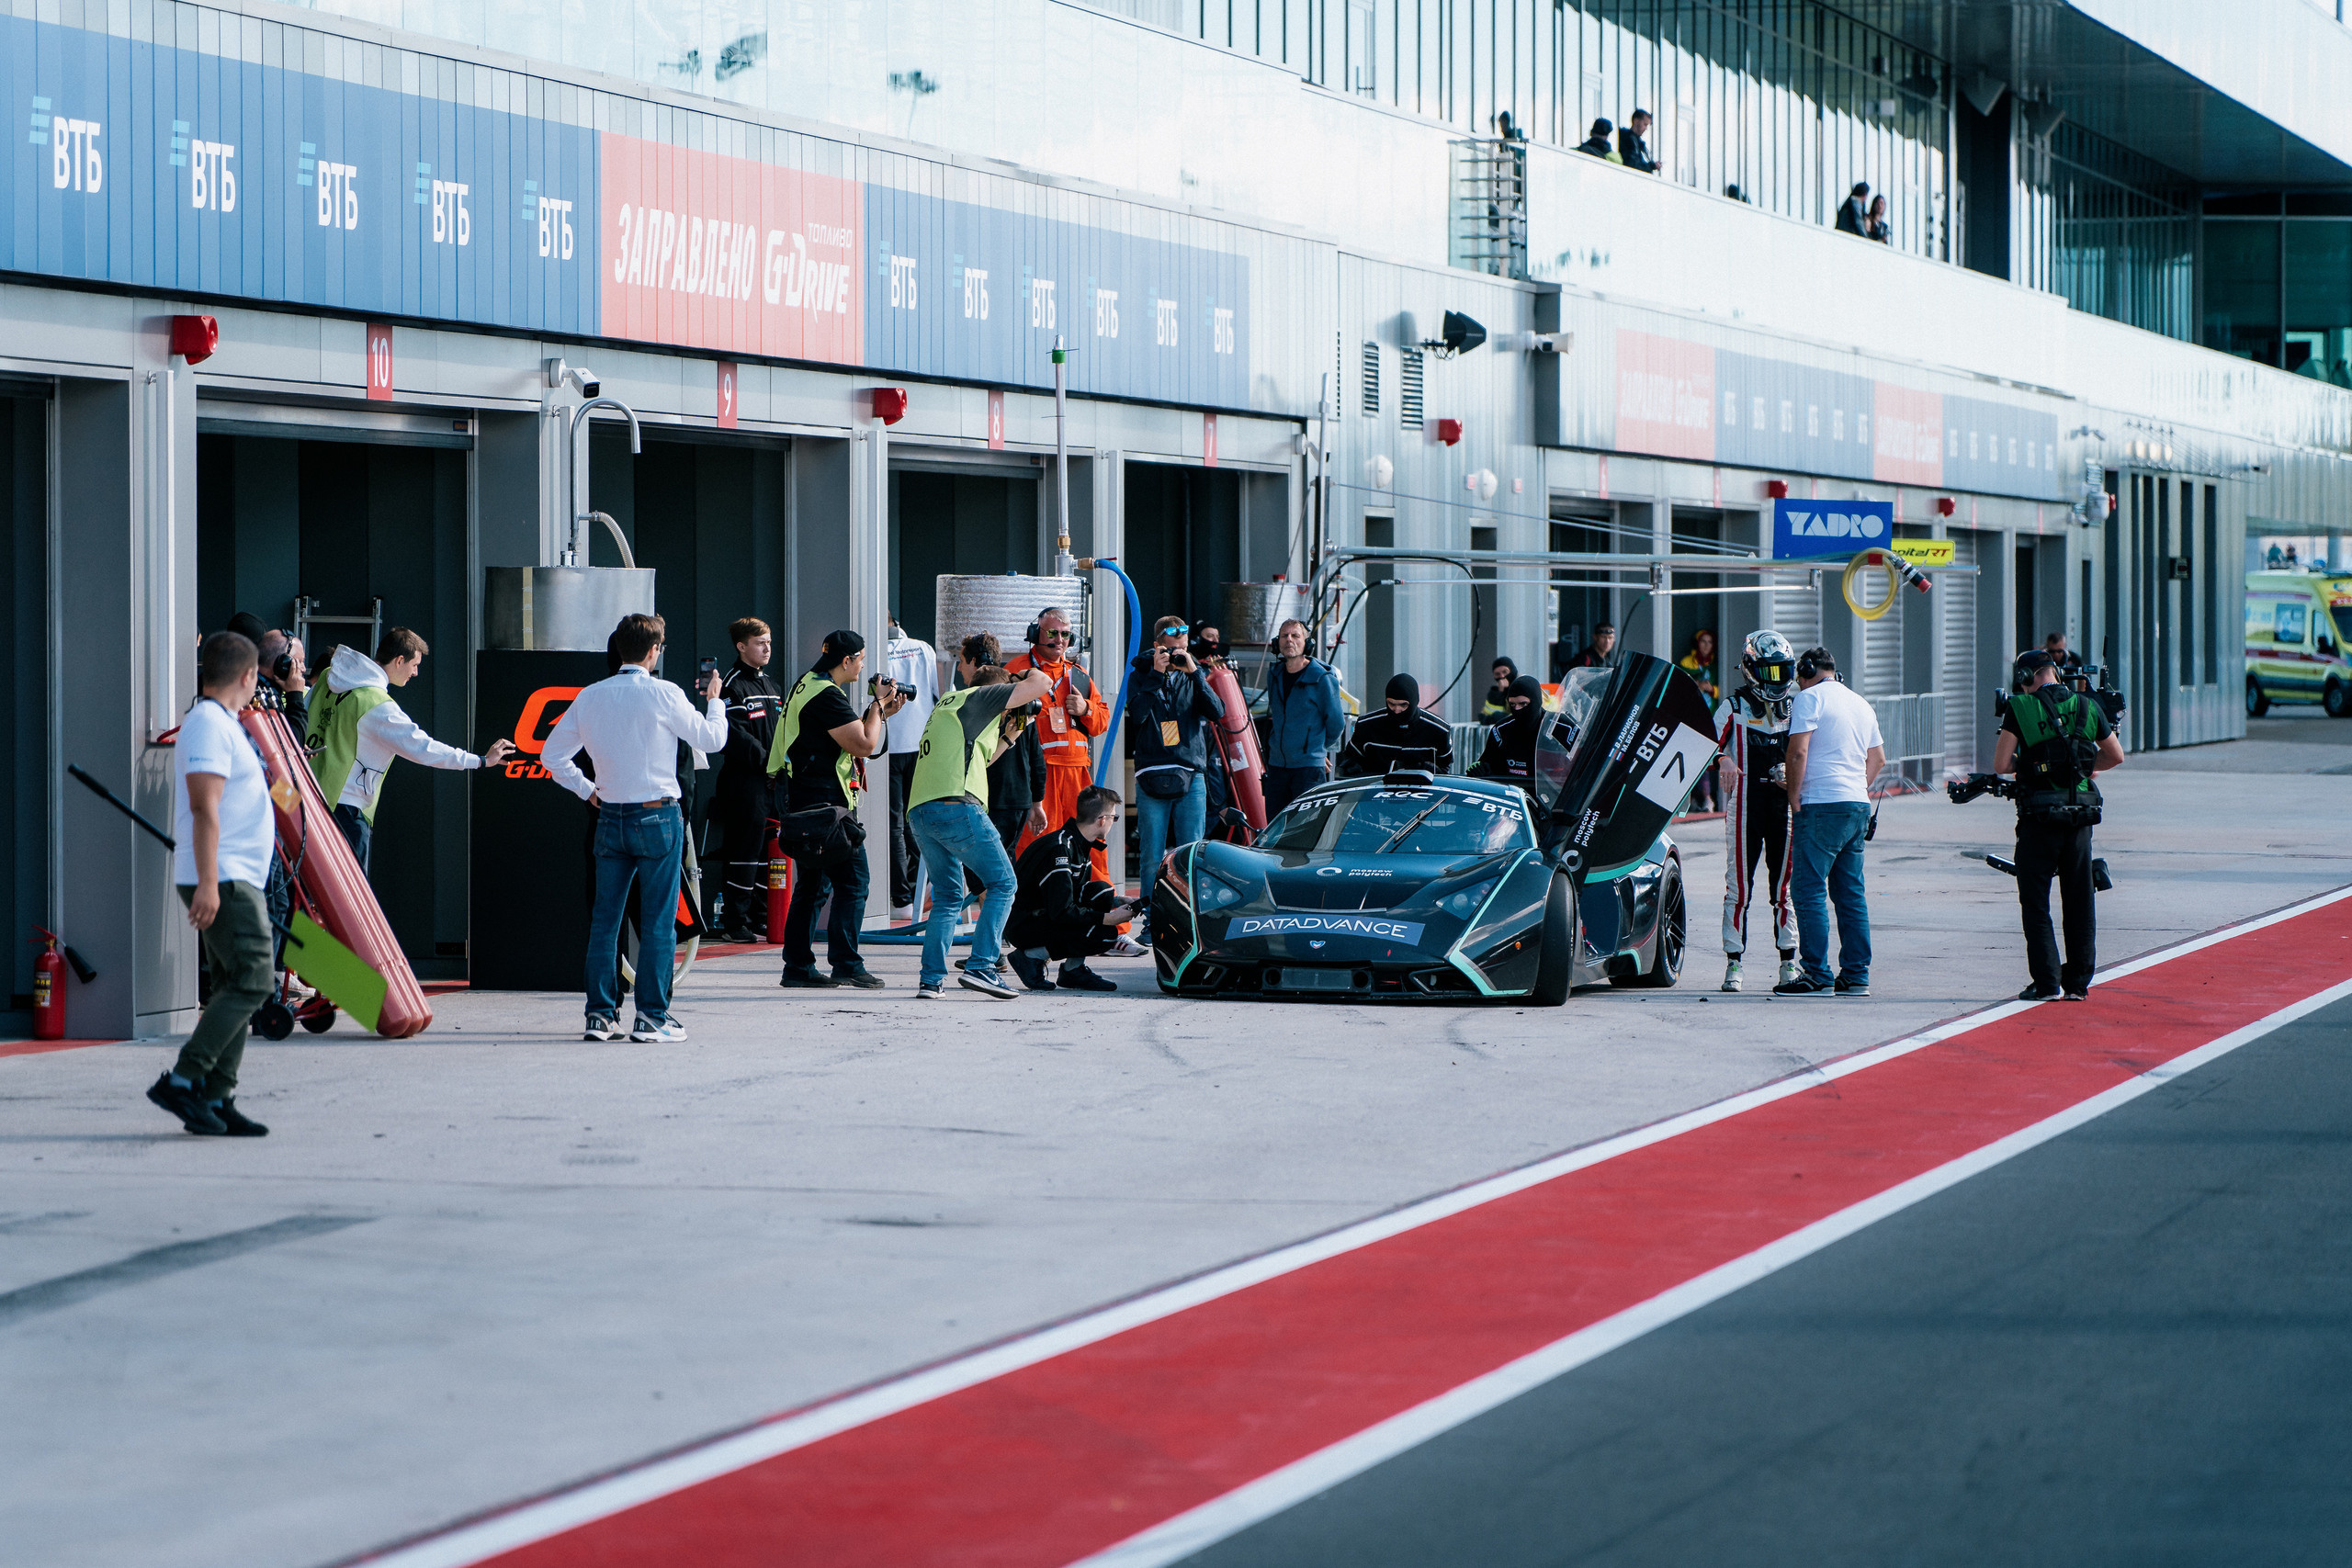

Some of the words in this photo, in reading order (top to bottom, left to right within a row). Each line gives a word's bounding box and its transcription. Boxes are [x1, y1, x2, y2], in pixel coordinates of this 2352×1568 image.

[53, 116, 102, 194] ВТБ
[192, 139, 236, 212] ВТБ
[318, 160, 358, 231] ВТБ
[433, 179, 470, 246] ВТБ
[538, 196, 574, 261] ВТБ
[615, 202, 756, 301] ЗАПРАВЛЕНО
[808, 222, 853, 249] ТОПЛИВО
[890, 254, 917, 310] ВТБ
[964, 267, 989, 321] ВТБ
[1032, 277, 1056, 330] ВТБ
[1096, 288, 1119, 338] ВТБ
[1157, 299, 1178, 347] ВТБ
[1214, 308, 1234, 355] ВТБ
[372, 337, 390, 388] 10
[723, 373, 732, 417] 9
[992, 400, 1001, 441] 8
[1786, 511, 1884, 538] YADRO
[1622, 721, 1641, 753] М.БЕЛОВ
[1636, 723, 1669, 762] ВТБ
[1660, 750, 1686, 784] 7
[1298, 795, 1340, 812] ВТБ
[1481, 802, 1523, 822] ВТБ
[1574, 808, 1593, 844] moscow
[1581, 810, 1600, 847] polytech
[1241, 918, 1408, 938] DATADVANCE
